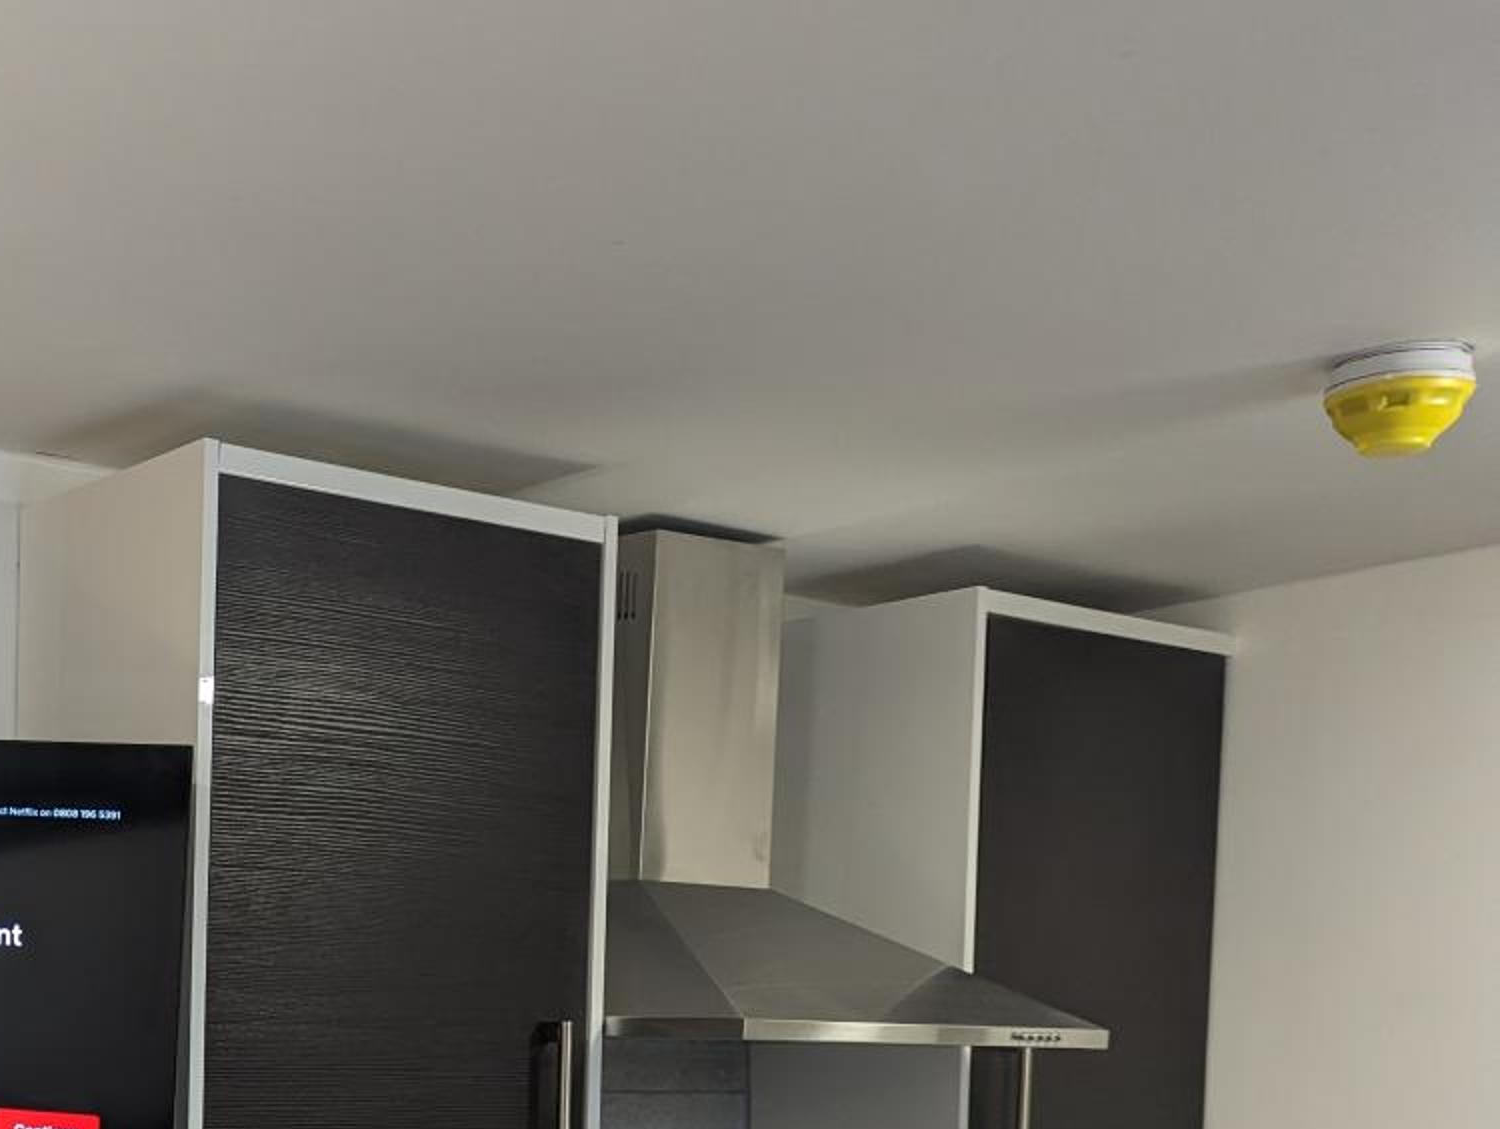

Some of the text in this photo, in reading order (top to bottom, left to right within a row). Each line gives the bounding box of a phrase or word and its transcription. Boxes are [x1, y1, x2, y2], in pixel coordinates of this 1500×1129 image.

[9, 806, 38, 817] Netflix
[40, 809, 51, 817] on
[53, 808, 78, 818] 0808
